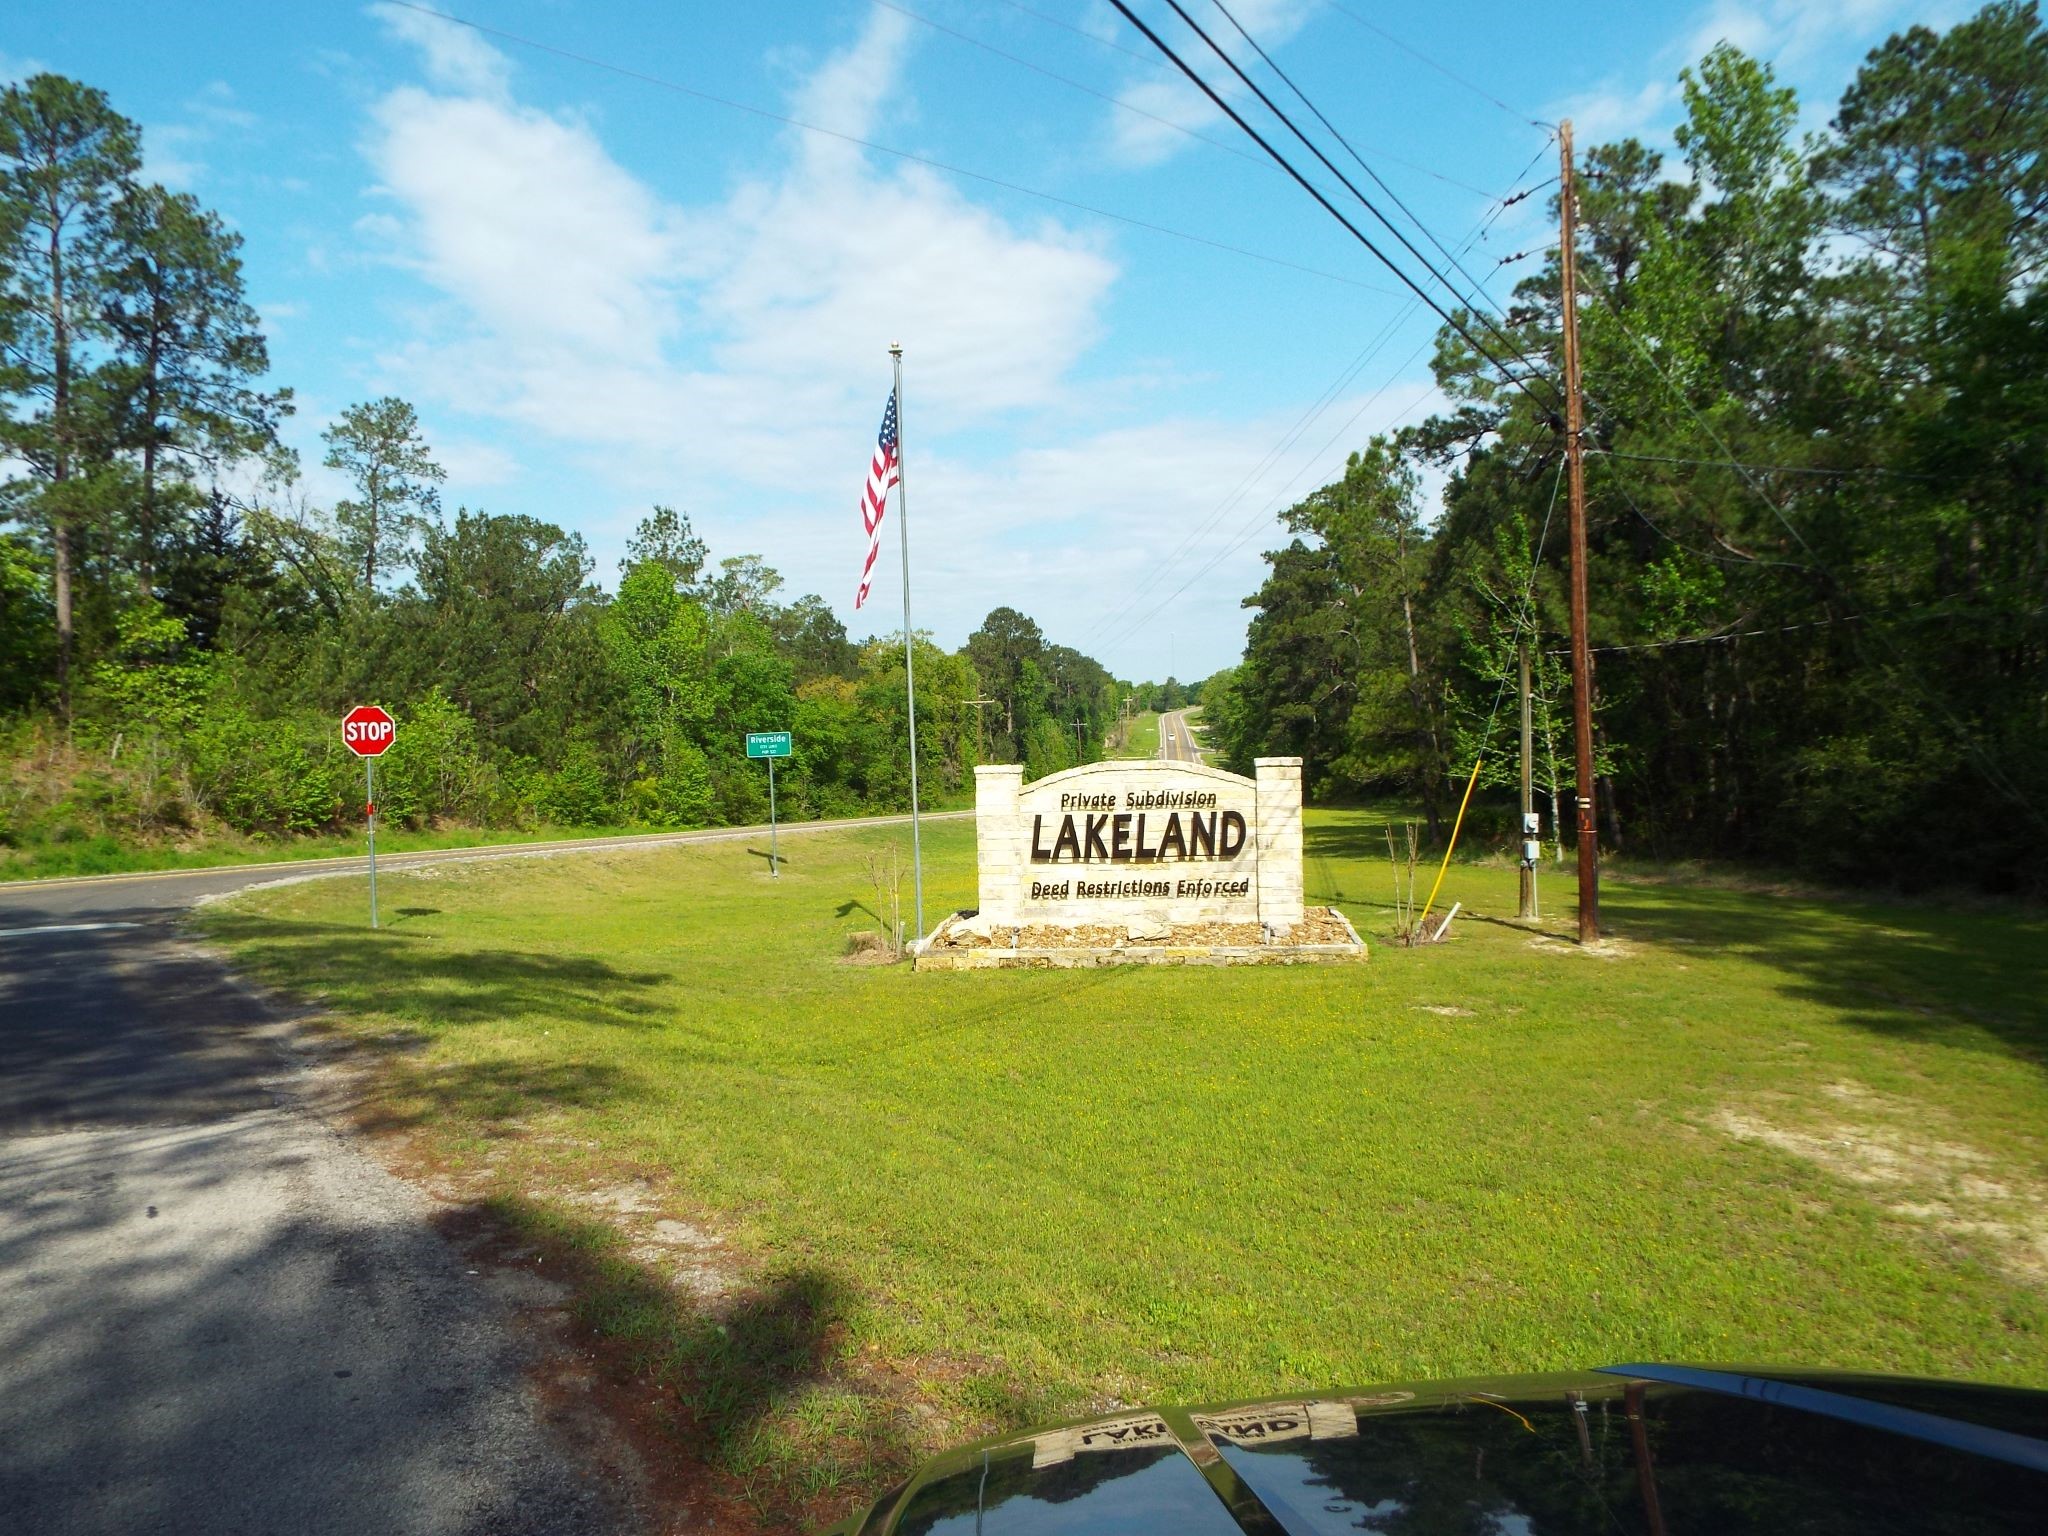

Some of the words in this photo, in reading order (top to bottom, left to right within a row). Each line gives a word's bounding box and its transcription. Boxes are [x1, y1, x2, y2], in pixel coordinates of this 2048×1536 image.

[346, 721, 392, 741] STOP
[750, 735, 786, 744] Riverside
[1061, 792, 1116, 808] Private
[1126, 790, 1217, 807] Subdivision
[1031, 811, 1247, 859] LAKELAND
[1031, 880, 1069, 897] Deed
[1077, 879, 1170, 896] Restrictions
[1177, 877, 1249, 898] Enforced
